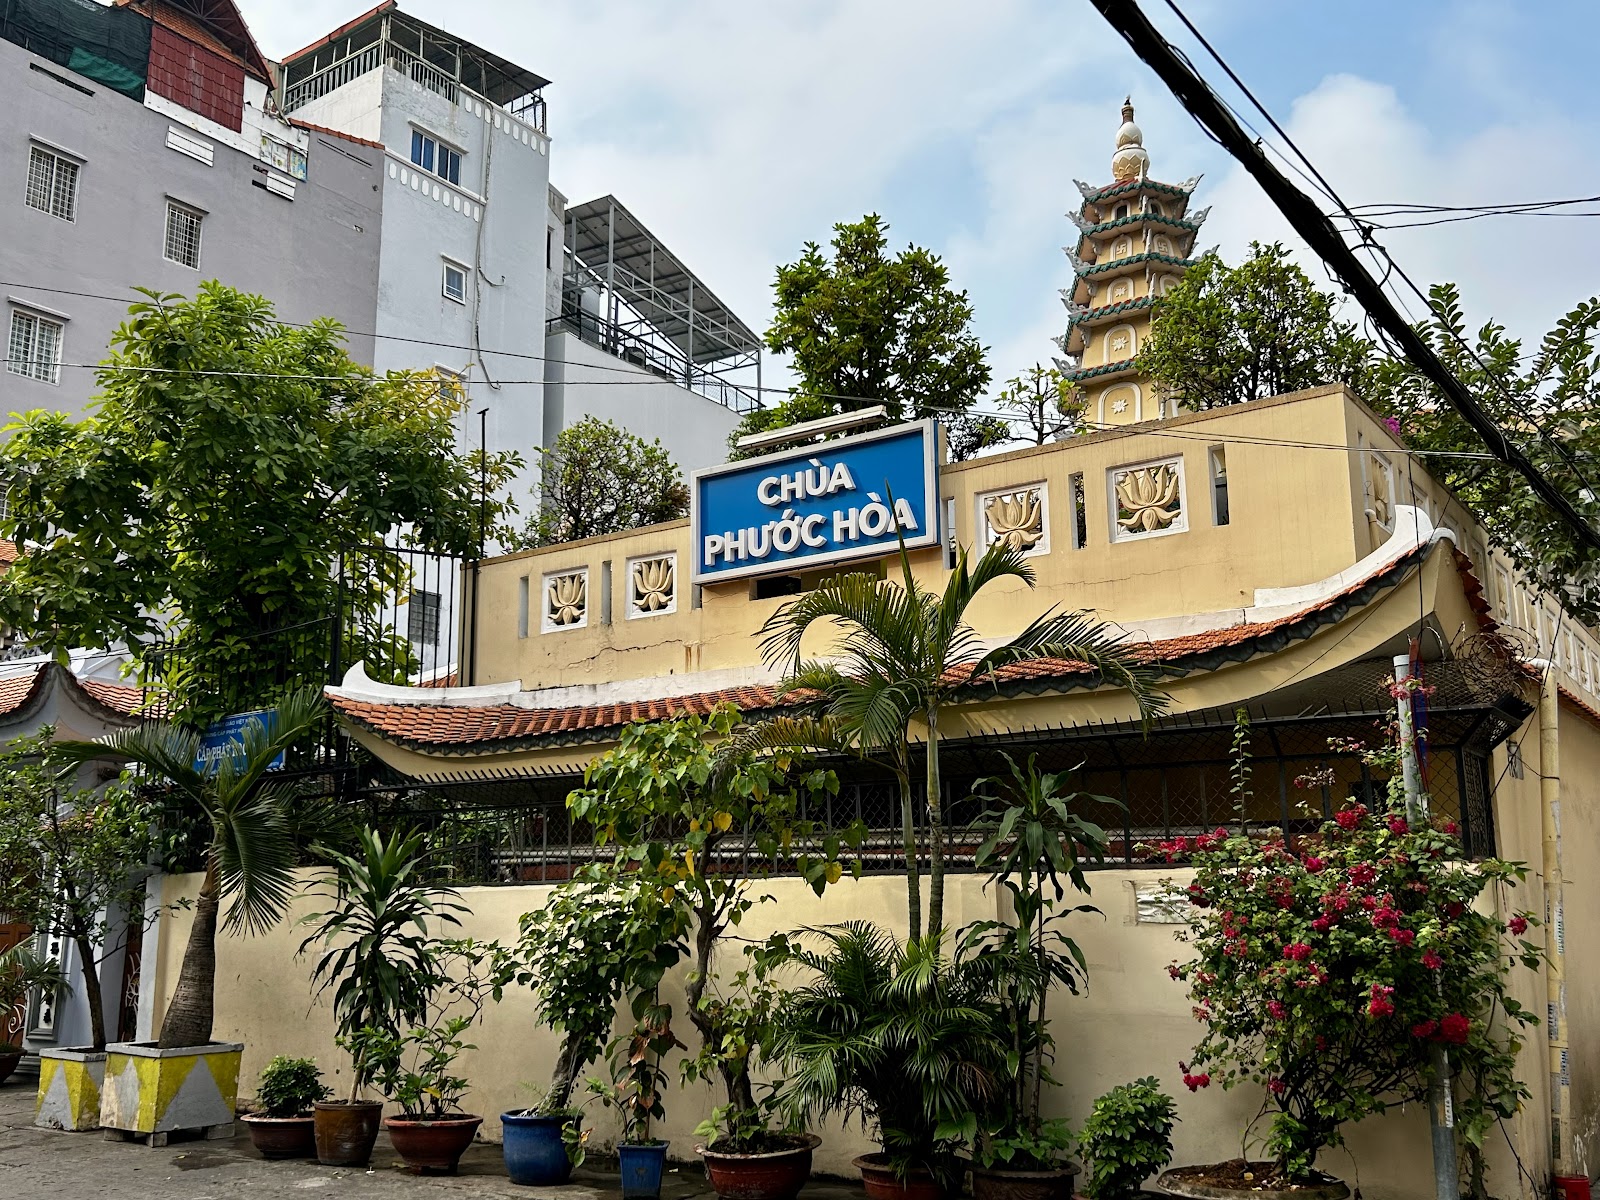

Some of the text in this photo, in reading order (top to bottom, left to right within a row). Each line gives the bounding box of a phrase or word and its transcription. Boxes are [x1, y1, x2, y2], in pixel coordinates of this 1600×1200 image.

[757, 458, 857, 507] CHÙA
[704, 491, 918, 566] PHƯỚC HÒA
